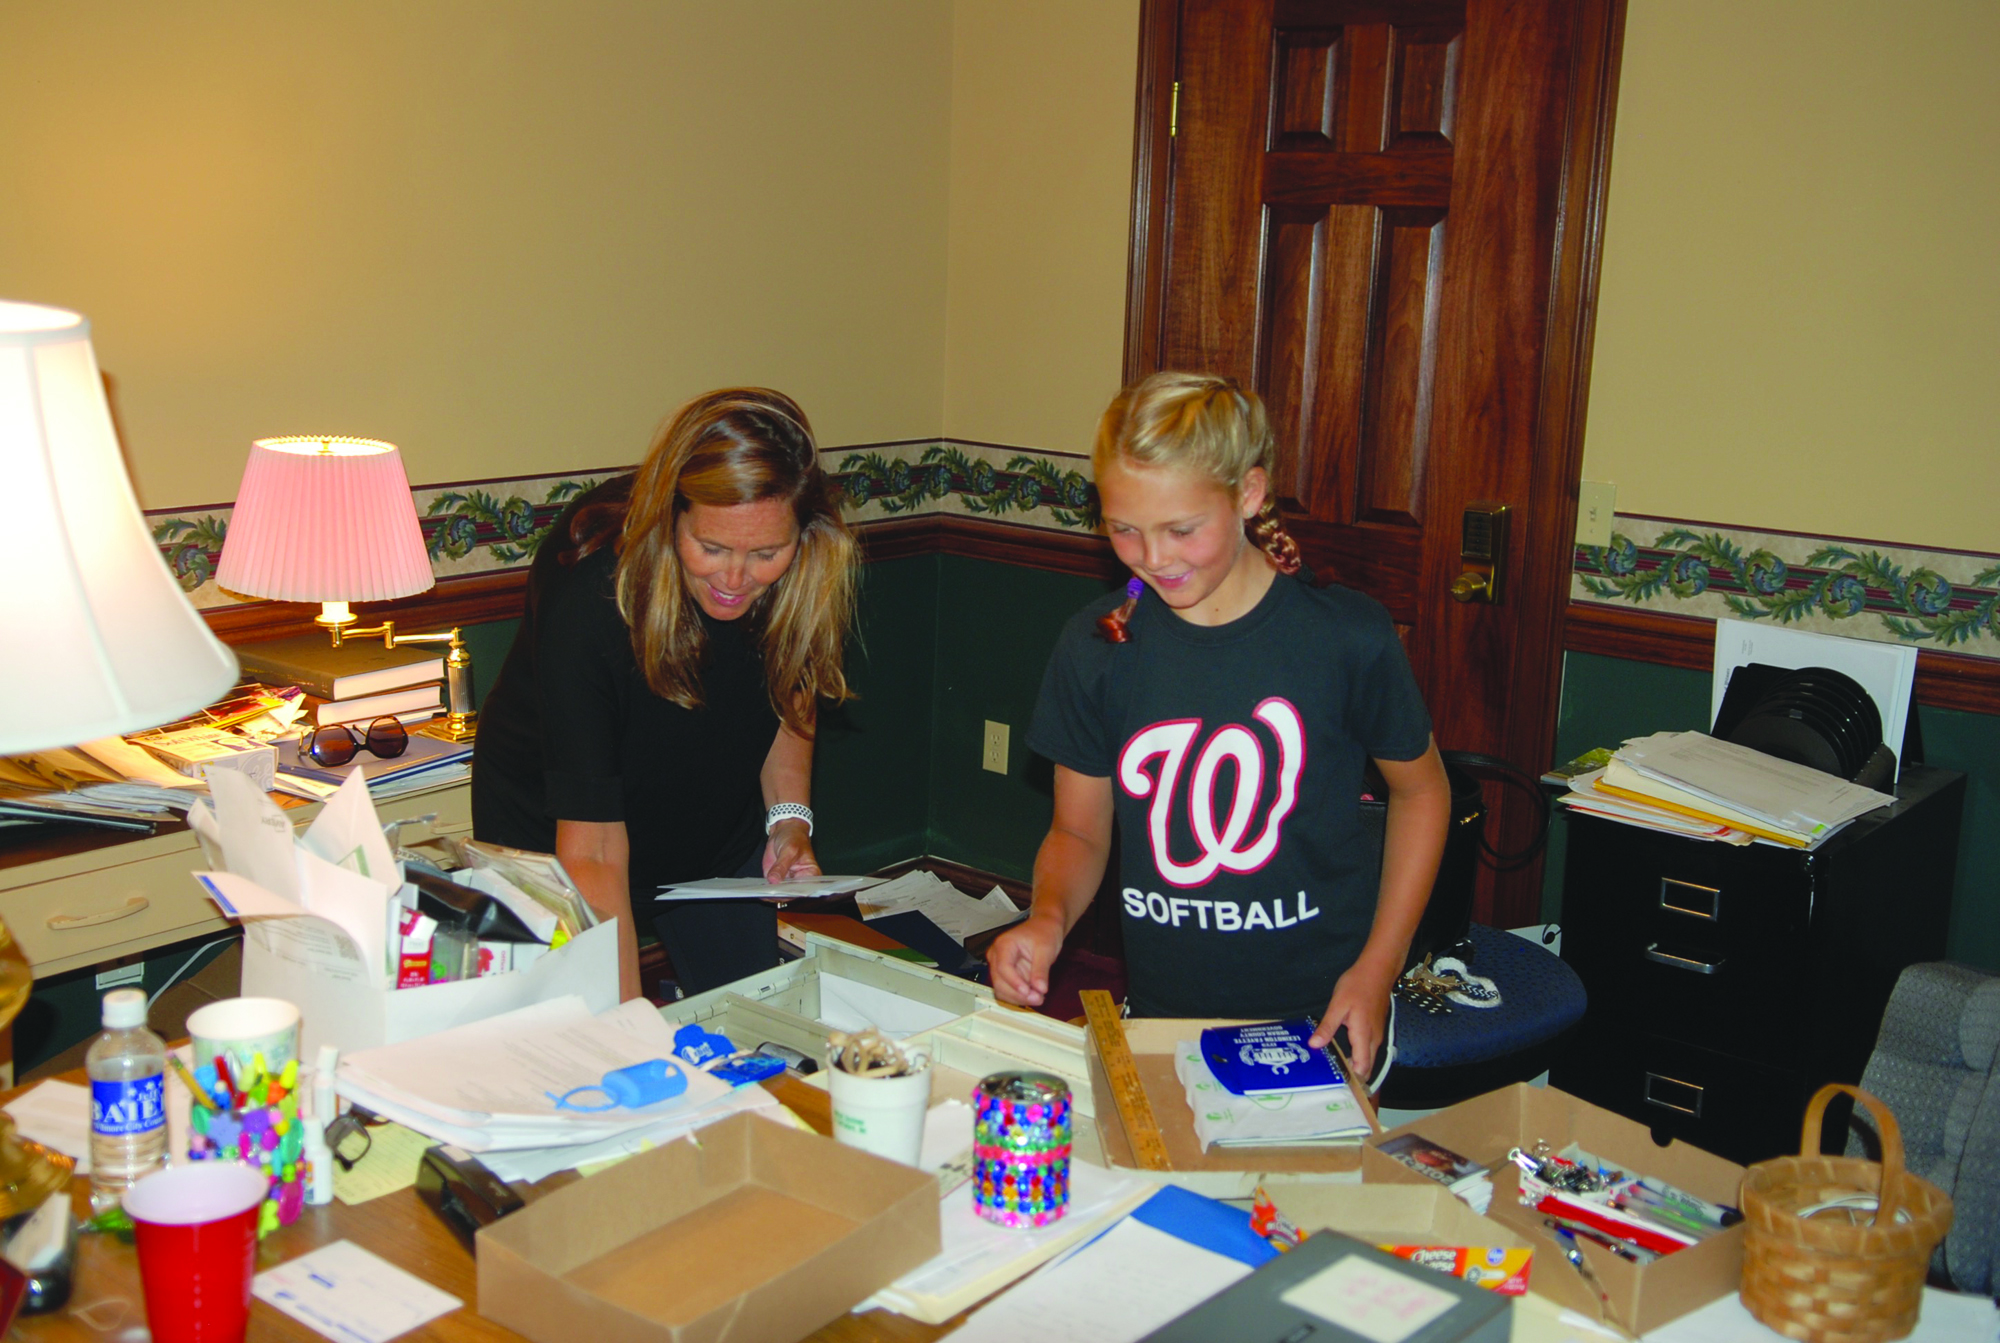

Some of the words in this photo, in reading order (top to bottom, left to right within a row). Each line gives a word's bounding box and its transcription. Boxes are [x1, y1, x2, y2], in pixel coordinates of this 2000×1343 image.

[1117, 695, 1307, 890] W
[1121, 888, 1320, 932] SOFTBALL
[1264, 1035, 1302, 1043] LEXINGTON
[1411, 1249, 1457, 1264] Cheese
